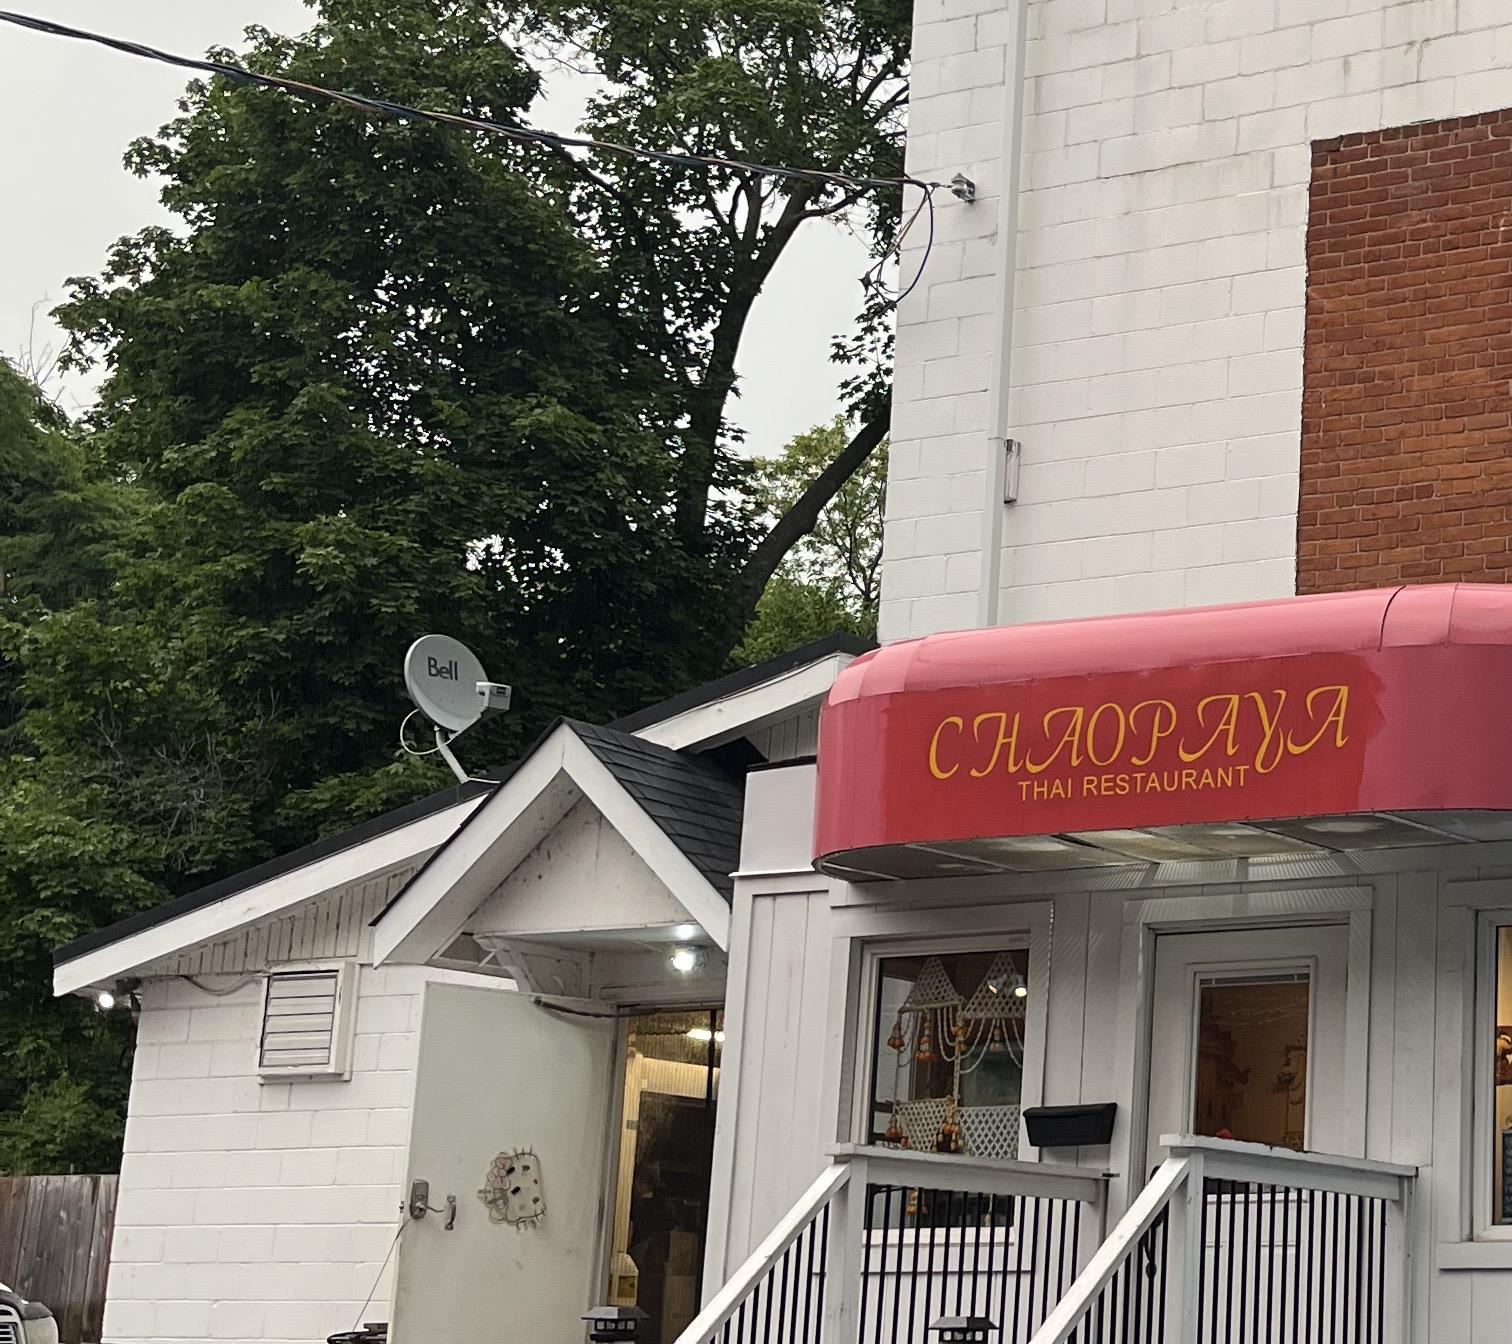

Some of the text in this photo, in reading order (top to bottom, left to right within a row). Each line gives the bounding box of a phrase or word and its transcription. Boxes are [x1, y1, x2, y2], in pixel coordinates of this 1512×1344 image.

[427, 656, 459, 681] Bell
[928, 685, 1350, 779] CHAOPAYA
[1018, 765, 1250, 801] THAI RESTAURANT
